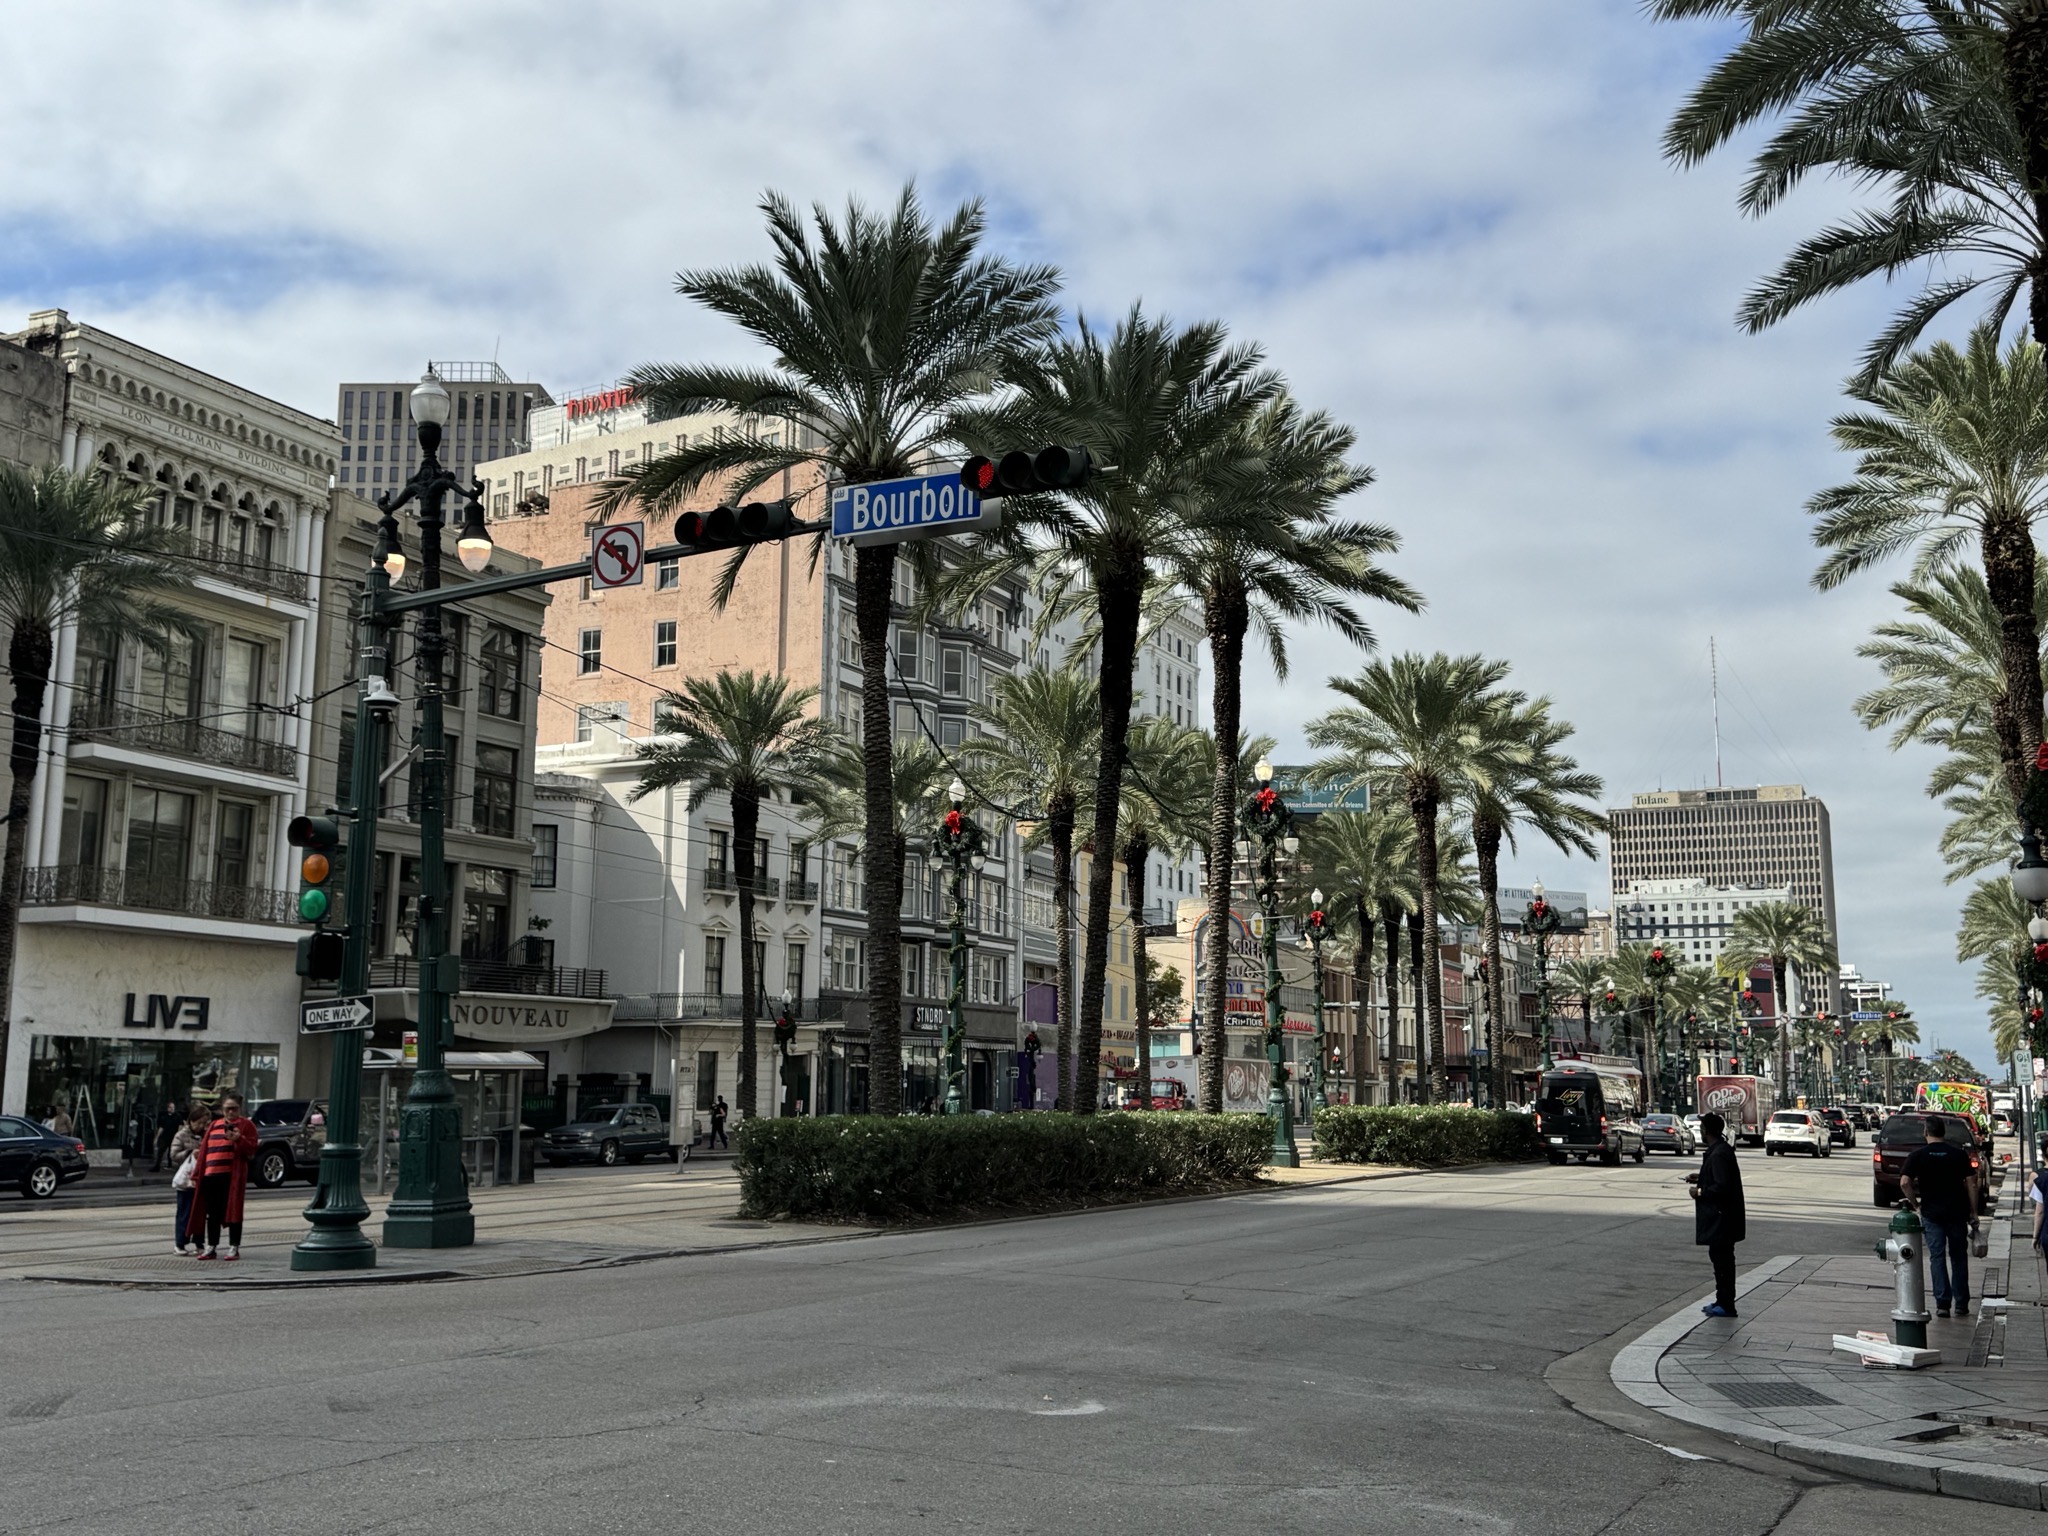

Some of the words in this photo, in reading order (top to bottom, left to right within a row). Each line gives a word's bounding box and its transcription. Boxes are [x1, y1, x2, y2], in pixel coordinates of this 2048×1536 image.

[122, 406, 151, 425] LEON
[167, 422, 222, 451] FELLMAN
[853, 480, 974, 530] Bourbon
[1634, 795, 1669, 805] Tulane
[308, 1010, 329, 1023] ONE
[332, 1007, 354, 1021] WAY
[455, 1004, 570, 1028] NOUVEAU
[916, 1007, 943, 1024] STNDRD
[1712, 1091, 1743, 1108] Pepper
[1721, 1088, 1734, 1098] Dr
